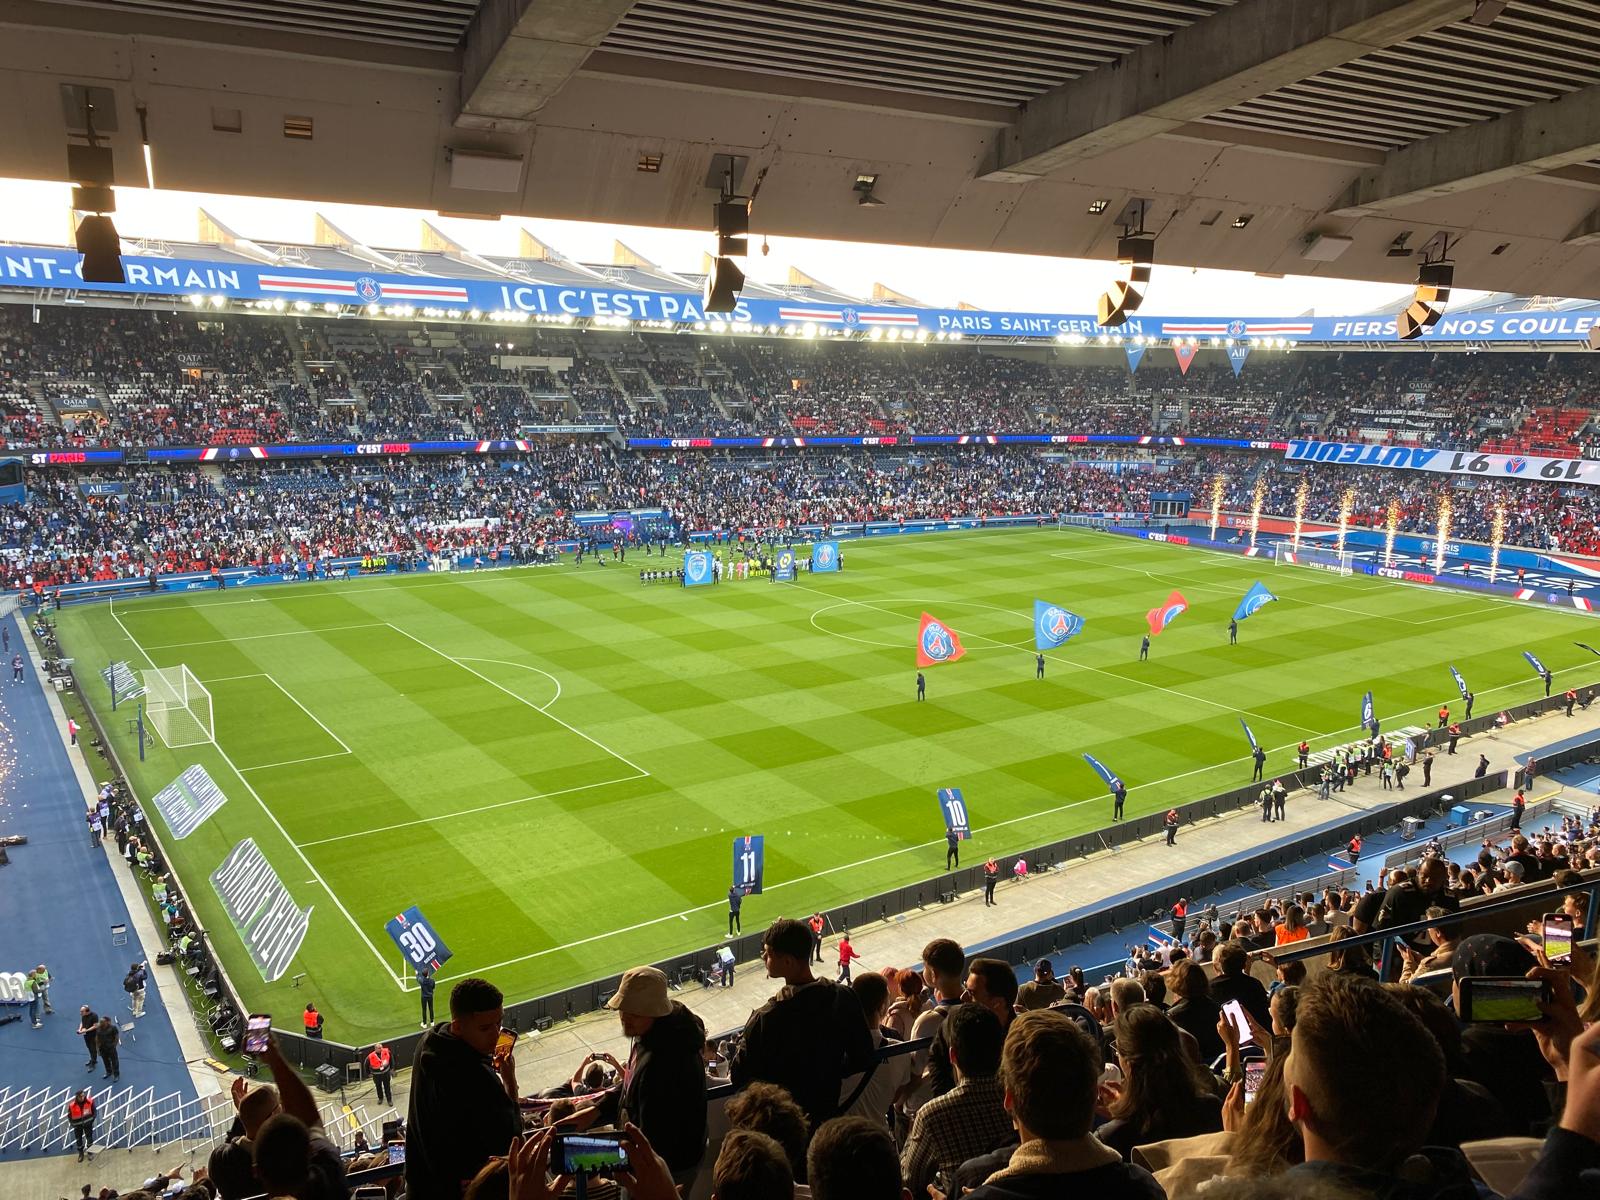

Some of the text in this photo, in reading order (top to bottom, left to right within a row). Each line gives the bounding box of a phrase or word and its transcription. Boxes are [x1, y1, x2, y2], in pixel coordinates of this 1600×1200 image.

[0, 256, 240, 290] NT-RMAIN
[501, 286, 547, 312] ICI
[559, 289, 649, 317] C'EST
[938, 315, 992, 330] PARIS
[1332, 320, 1397, 336] FIERS
[1441, 319, 1494, 335] NOS
[1502, 316, 1600, 334] COULE
[357, 444, 382, 454] C'EST
[384, 444, 410, 453] PARIS
[671, 439, 690, 447] C'EST
[692, 439, 712, 447] PARIS
[1271, 442, 1288, 450] PARI
[31, 453, 86, 464] ST PARIS
[1289, 440, 1440, 469] AUTEUIL
[1148, 533, 1166, 542] C'EST
[1167, 535, 1189, 545] PARIS
[1432, 542, 1460, 553] PRIS
[1309, 561, 1324, 570] VISIT
[1378, 567, 1404, 579] C'EST
[1404, 572, 1435, 584] PARIS
[1364, 703, 1372, 720] 6
[1095, 761, 1112, 780] 7
[946, 800, 967, 827] 10
[740, 851, 755, 883] 11
[216, 838, 315, 982] QATAR AIRWAYS
[399, 922, 436, 963] 30
